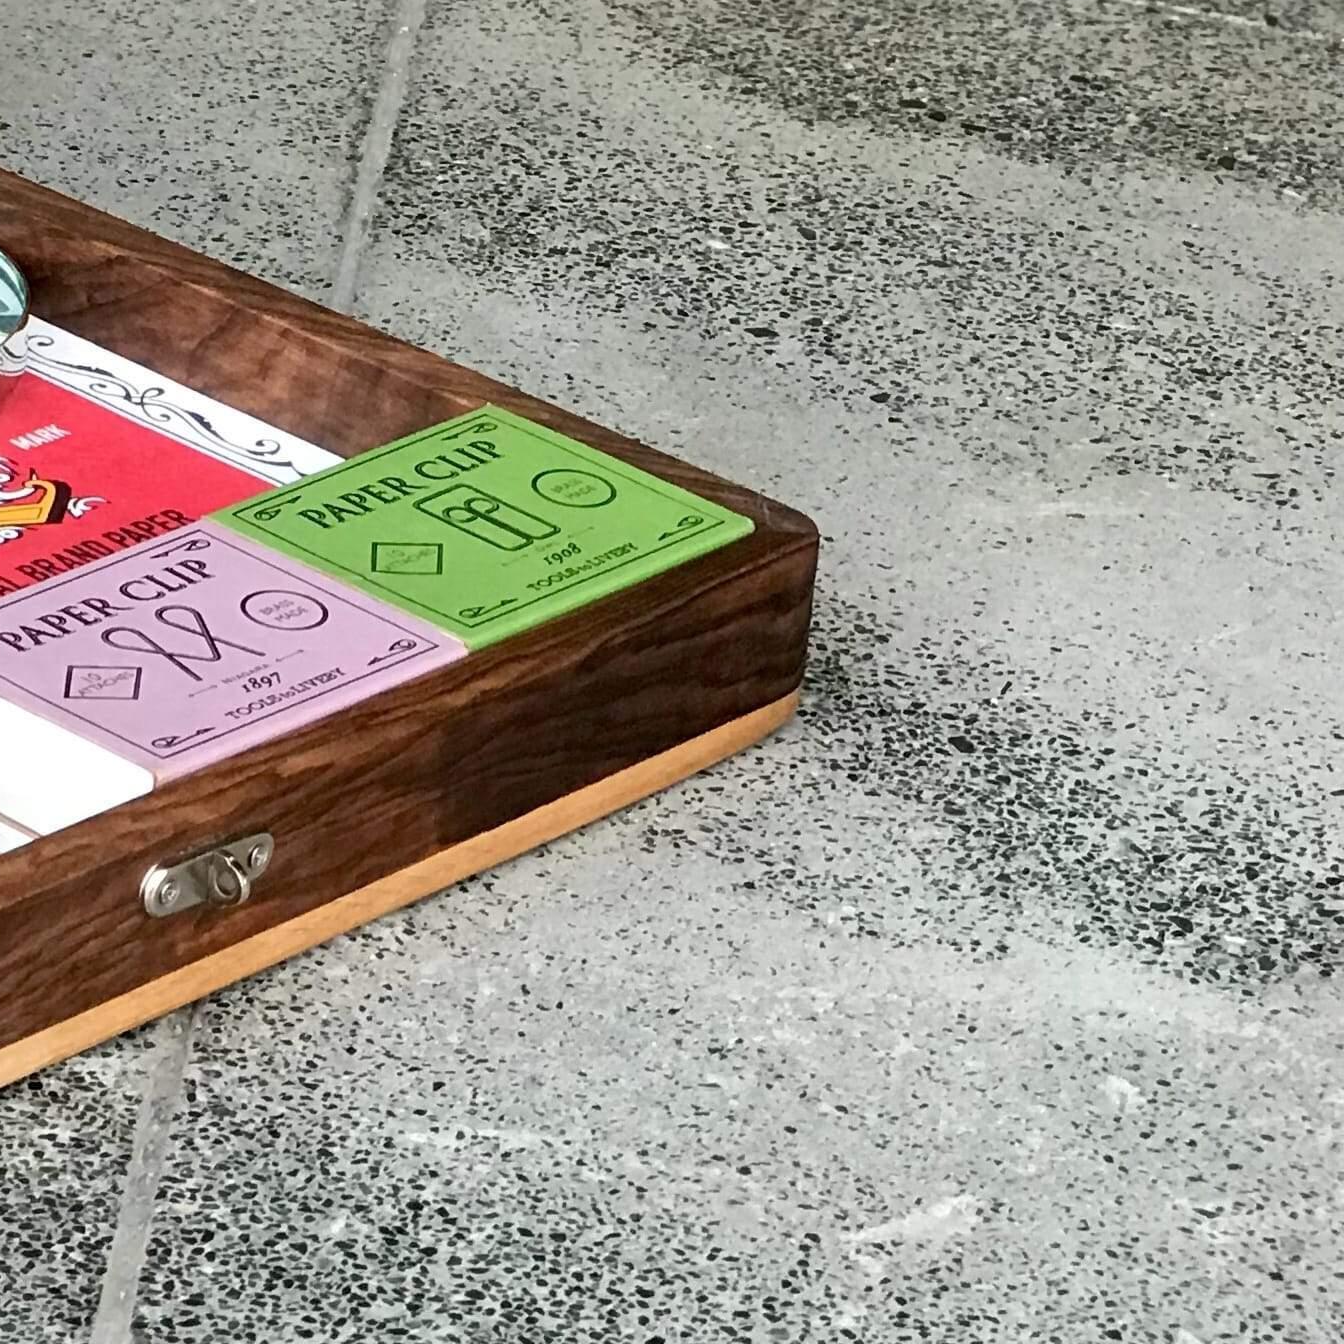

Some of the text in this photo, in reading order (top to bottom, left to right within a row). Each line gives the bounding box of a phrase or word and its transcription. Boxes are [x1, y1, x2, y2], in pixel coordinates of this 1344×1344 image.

[7, 423, 72, 451] MARK
[297, 437, 510, 530] PAPER CLIP
[15, 539, 116, 582] BRAND
[101, 508, 197, 551] PAPER
[542, 541, 583, 567] 1908
[118, 557, 217, 602] CLIP
[273, 604, 310, 623] MADE
[241, 671, 282, 694] 1897
